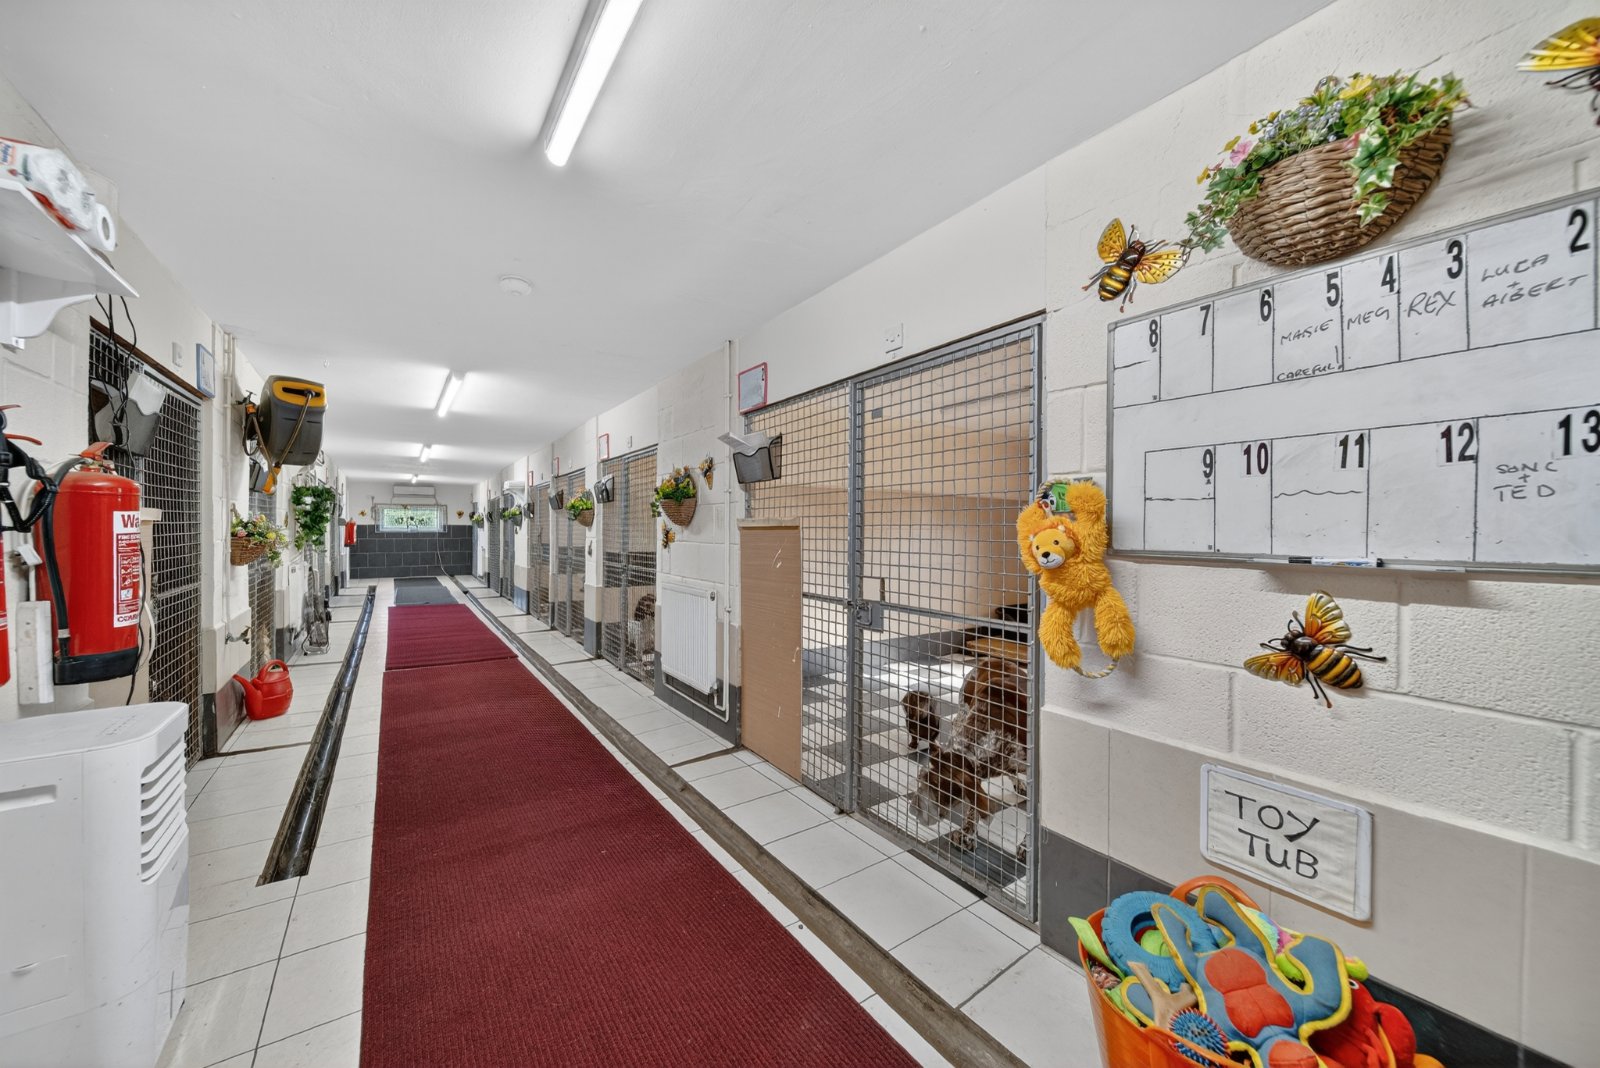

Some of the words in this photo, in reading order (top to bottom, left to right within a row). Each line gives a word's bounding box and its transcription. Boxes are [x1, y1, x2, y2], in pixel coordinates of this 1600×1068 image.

[1568, 209, 1590, 254] 2
[1381, 256, 1397, 293] 4
[1446, 240, 1463, 279] 3
[1481, 253, 1550, 282] LUCA
[1260, 289, 1272, 322] 6
[1326, 271, 1340, 307] 5
[1407, 290, 1456, 318] REX
[1149, 319, 1159, 347] 8
[1200, 304, 1211, 336] 7
[1347, 306, 1390, 330] MEG
[1440, 422, 1476, 463] 12
[1558, 410, 1600, 456] 13
[1203, 449, 1213, 478] 9
[1243, 442, 1269, 475] 10
[1338, 433, 1365, 469] 11
[1492, 484, 1556, 502] TED
[1224, 790, 1320, 843] TOY
